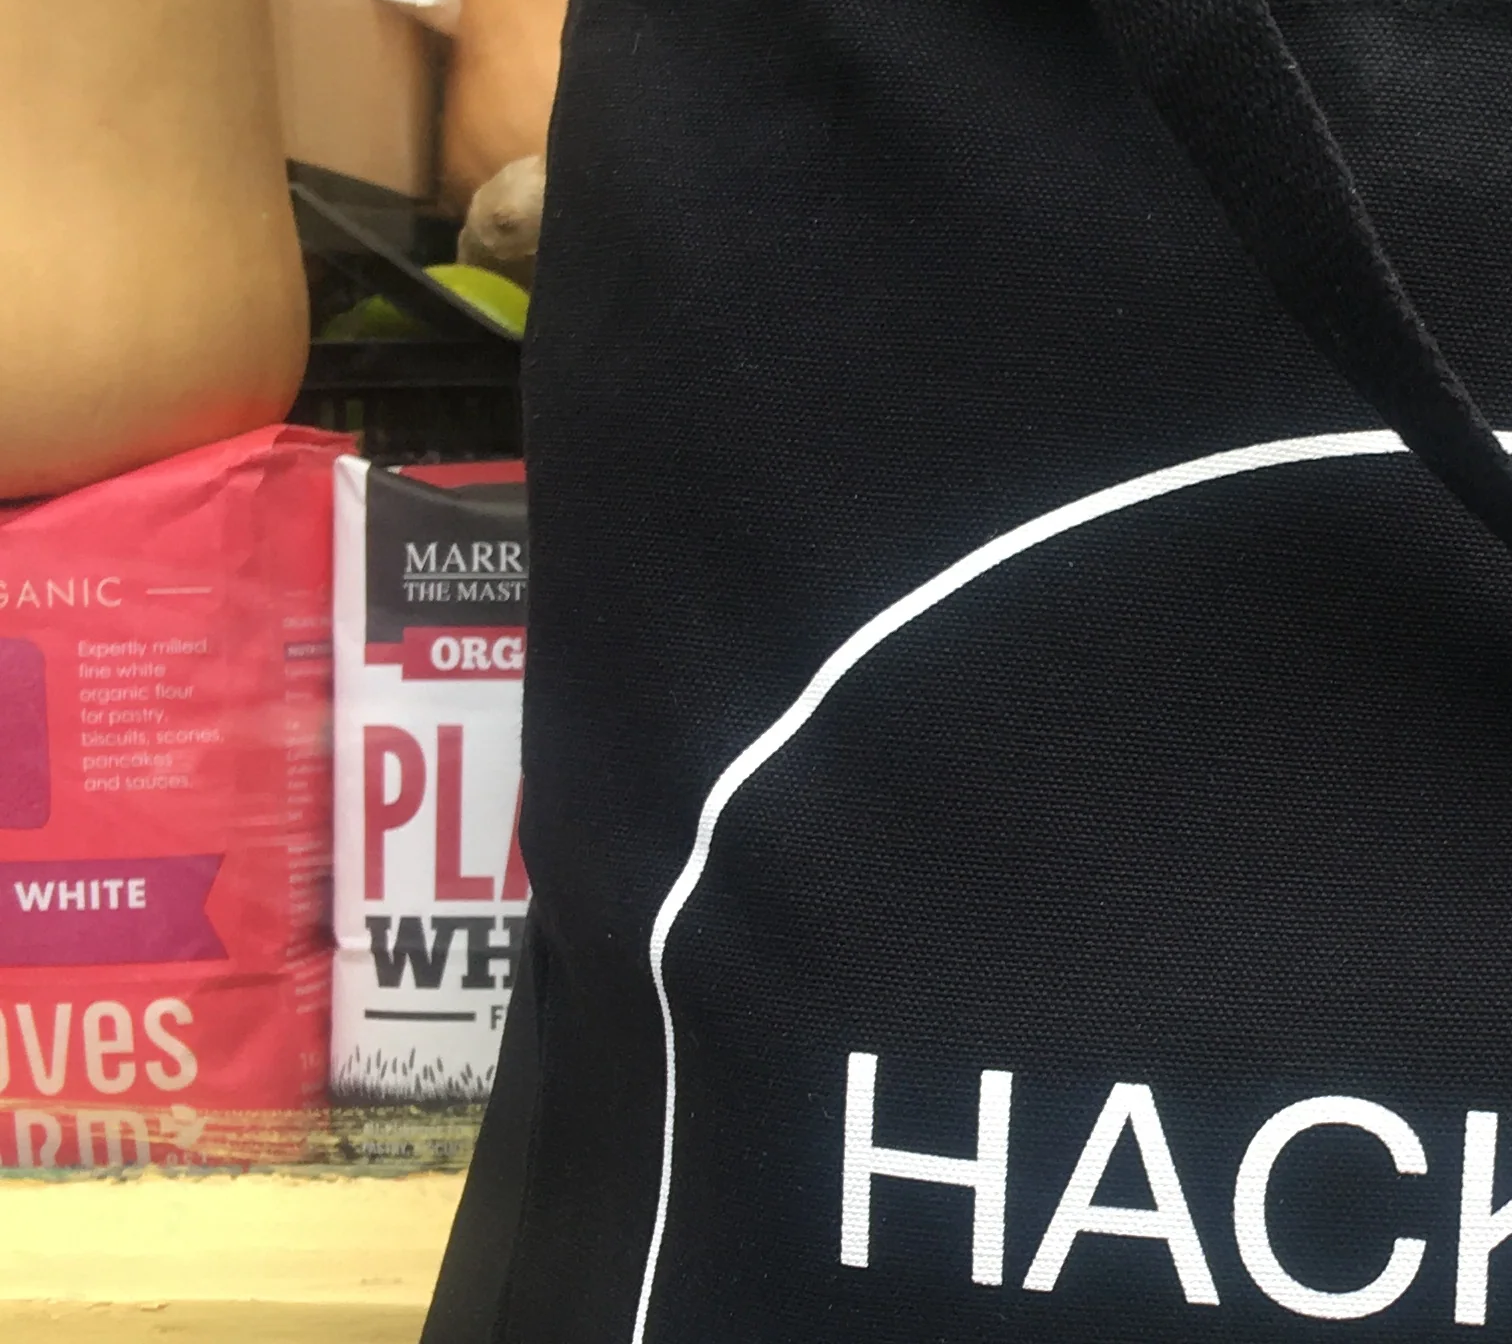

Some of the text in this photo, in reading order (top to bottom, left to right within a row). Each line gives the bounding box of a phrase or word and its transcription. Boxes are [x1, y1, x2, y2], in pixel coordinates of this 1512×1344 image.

[404, 541, 522, 573] MARR
[404, 582, 449, 602] THE
[78, 638, 147, 659] Expertly
[430, 636, 525, 671] ORG
[79, 662, 167, 679] fine white
[80, 682, 195, 706] organic flour
[81, 708, 105, 725] for
[82, 751, 173, 771] pancakes
[84, 773, 120, 792] and
[14, 878, 147, 912] WHITE
[0, 997, 198, 1096] ves
